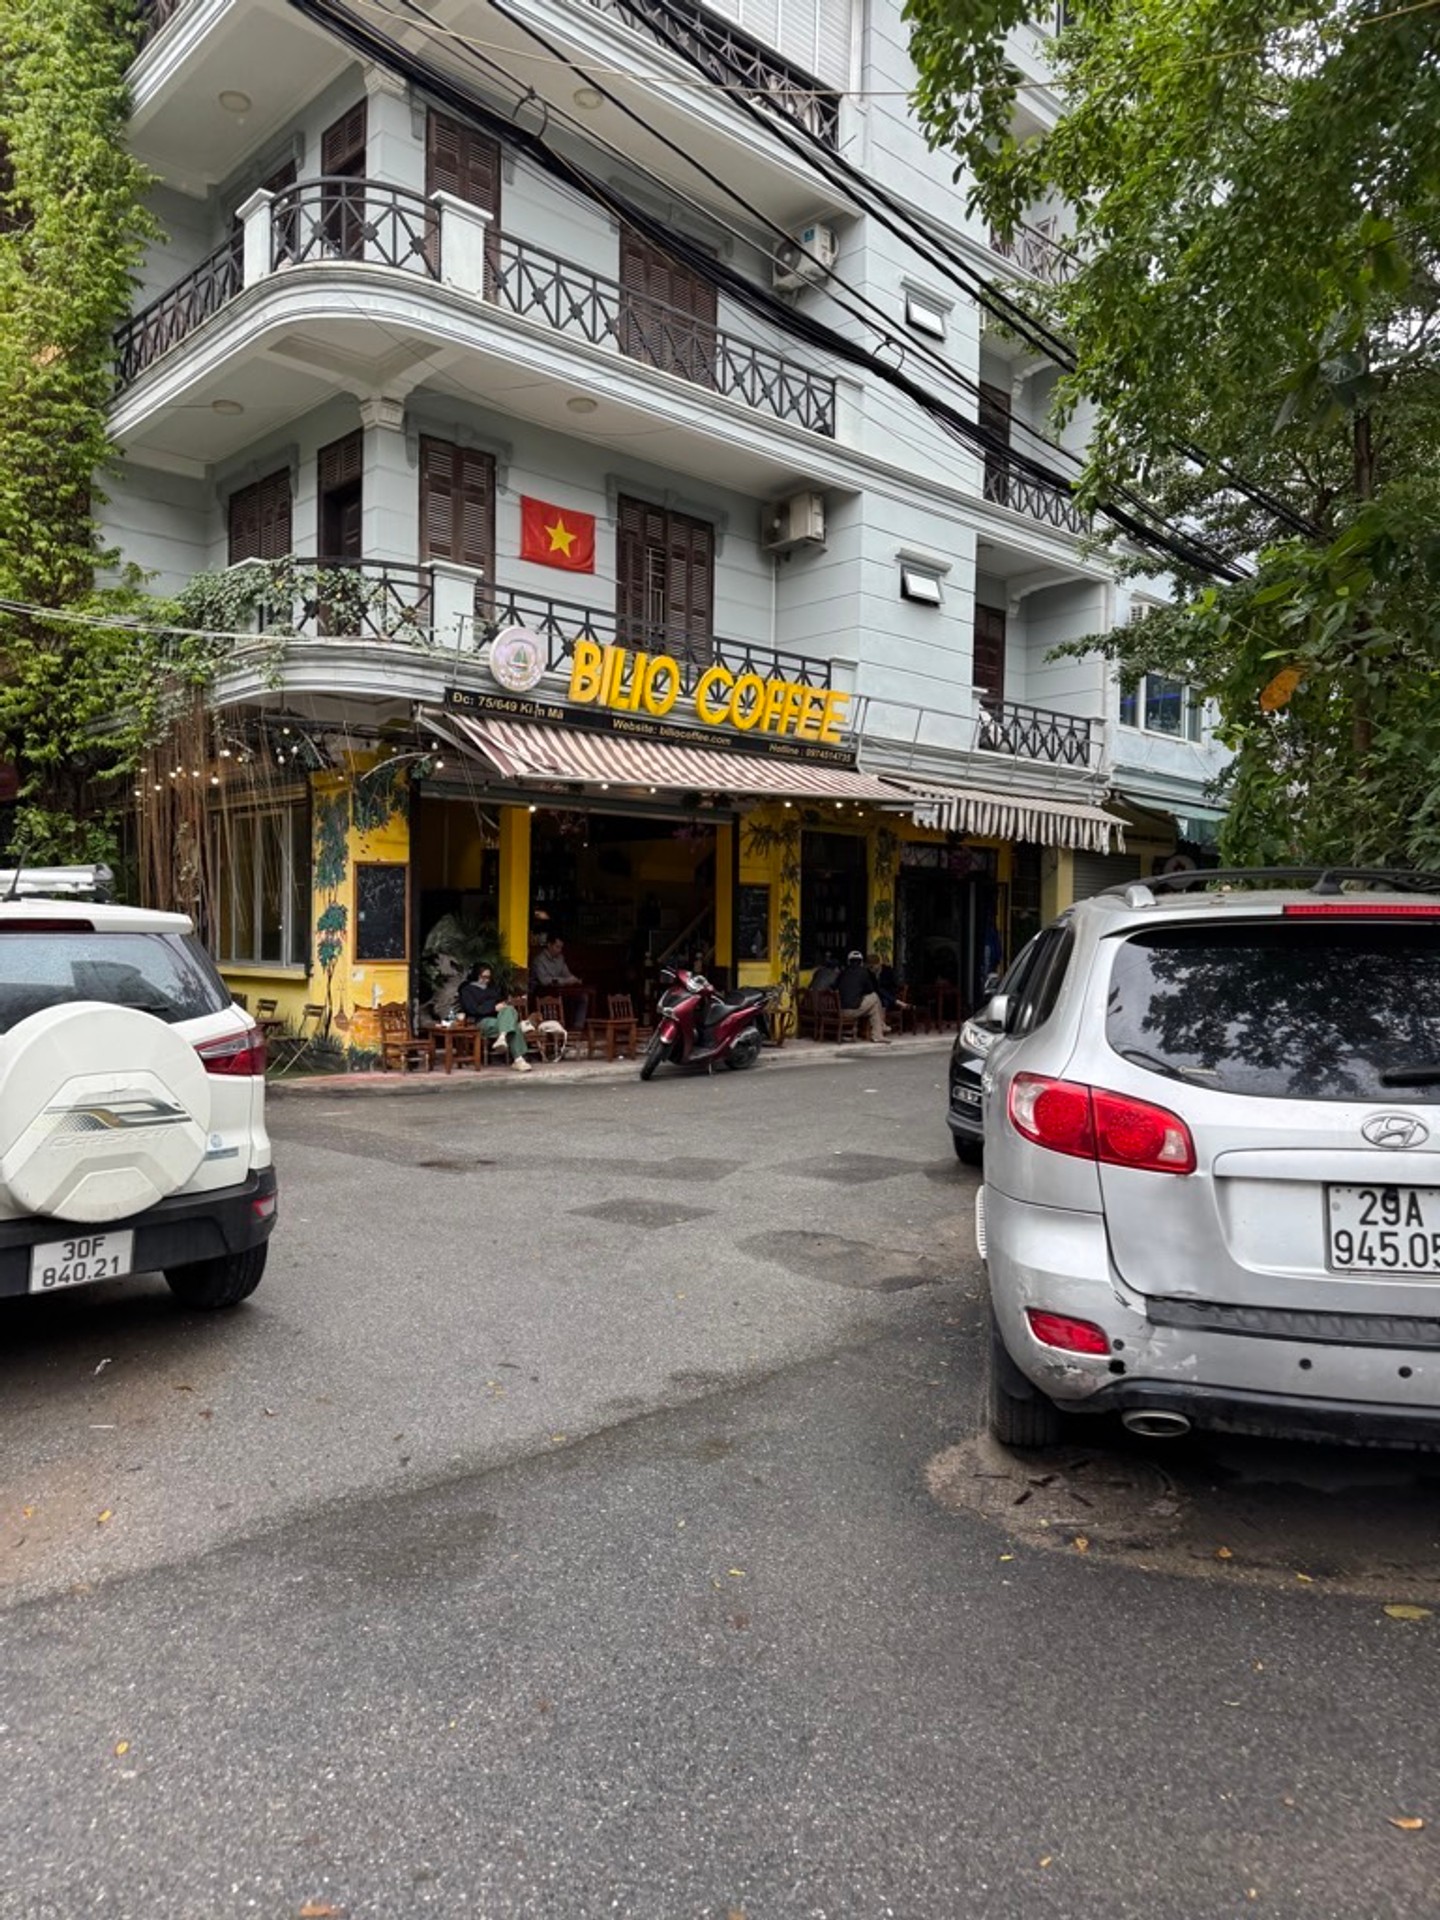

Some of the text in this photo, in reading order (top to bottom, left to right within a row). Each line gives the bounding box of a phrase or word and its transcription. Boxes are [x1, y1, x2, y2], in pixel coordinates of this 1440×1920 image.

[478, 696, 518, 712] 75/649
[569, 640, 850, 743] BILIO COFFEE
[613, 719, 658, 734] Website:
[1358, 1190, 1424, 1228] 29A
[62, 1236, 106, 1262] 30F
[43, 1255, 119, 1287] 840.21
